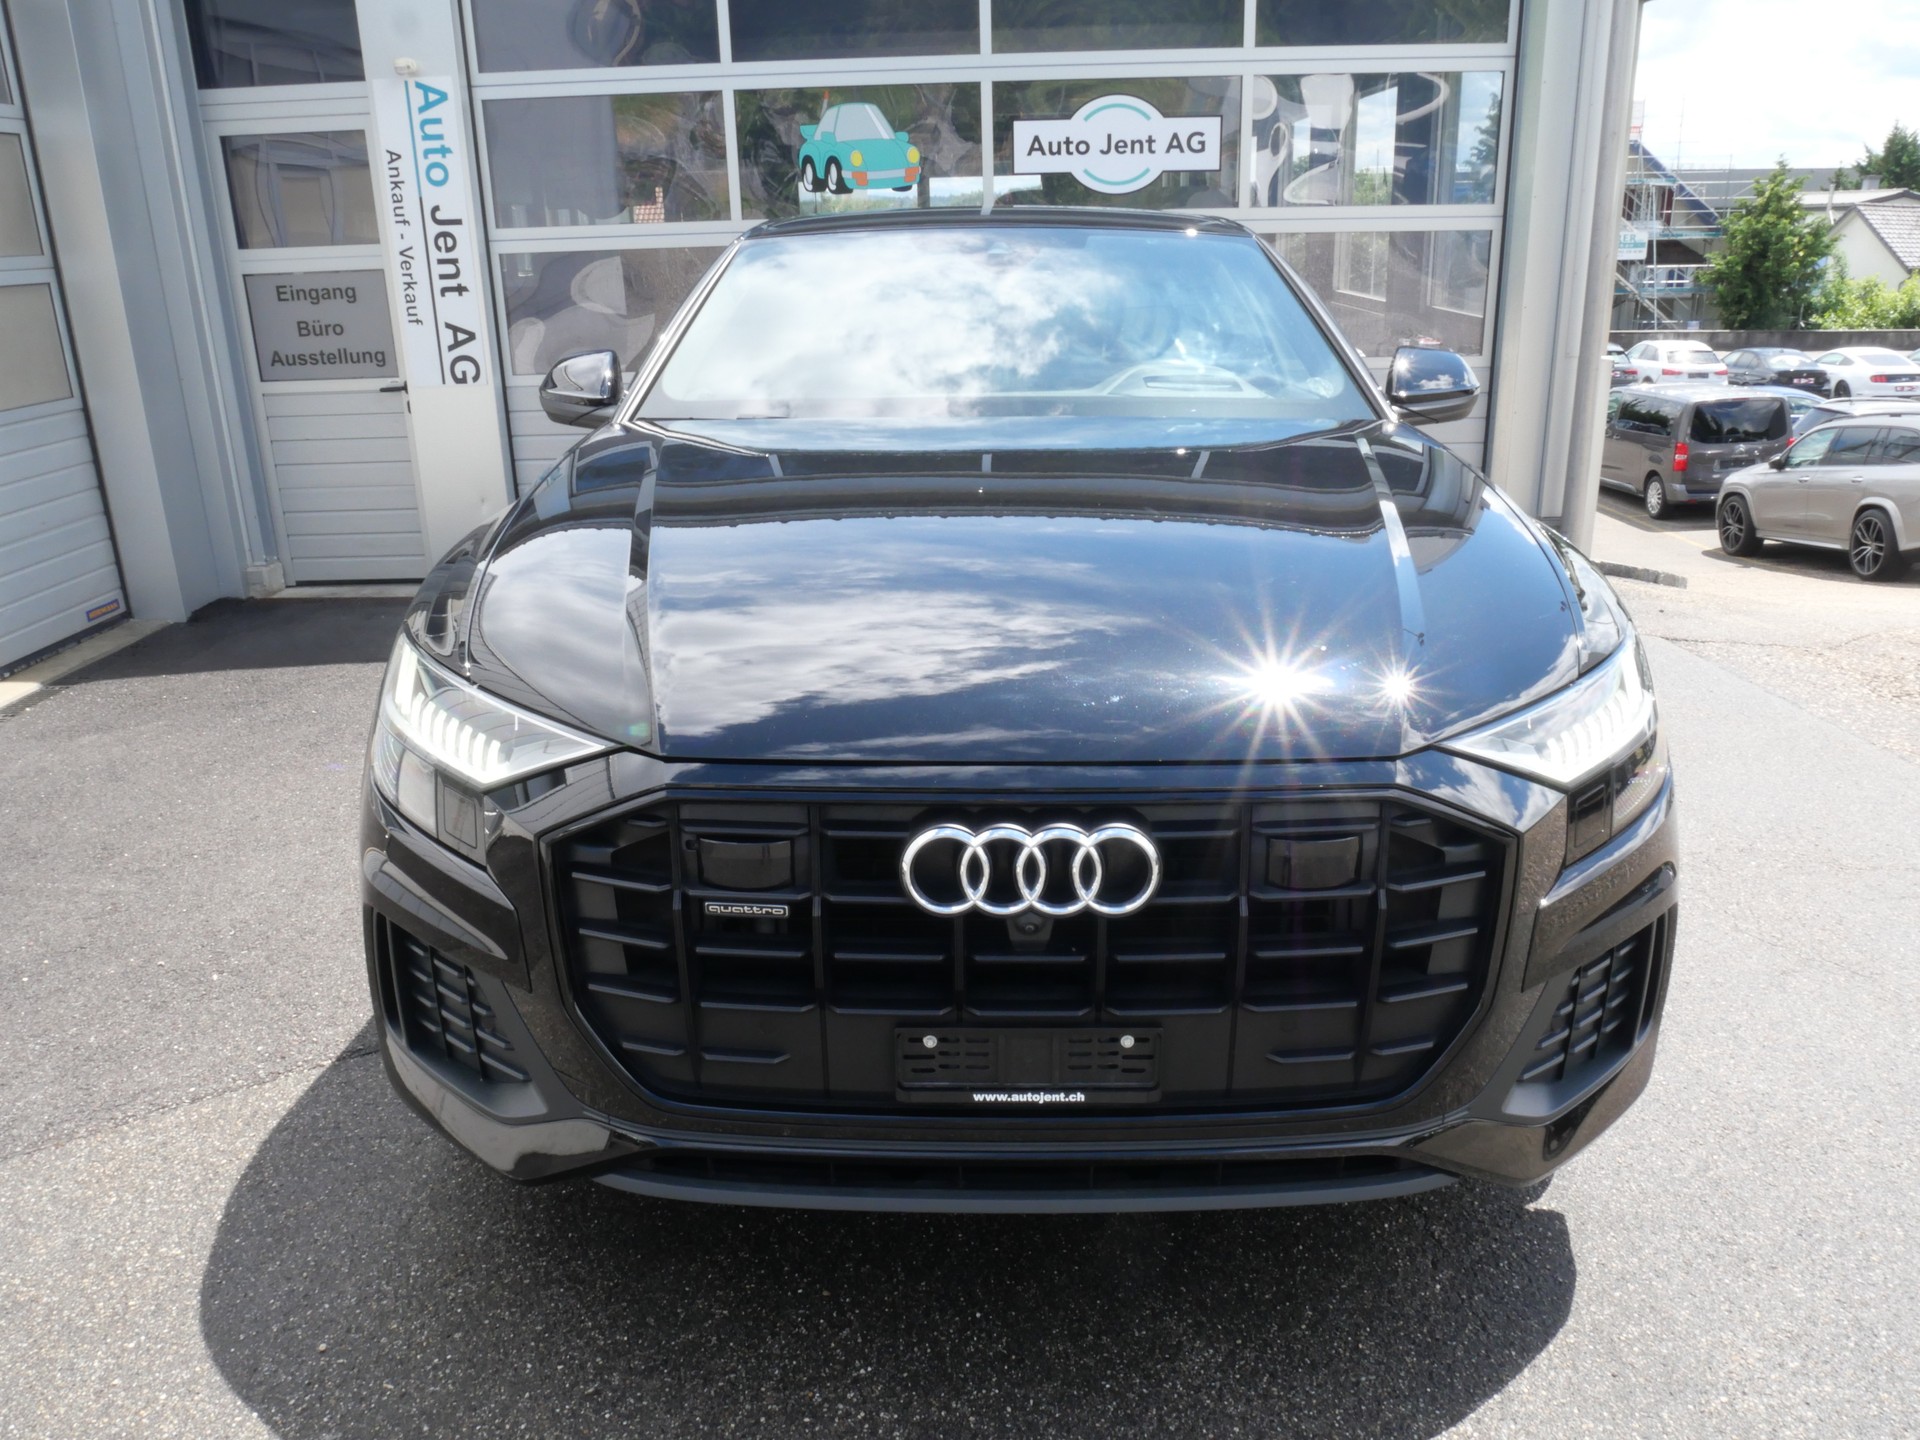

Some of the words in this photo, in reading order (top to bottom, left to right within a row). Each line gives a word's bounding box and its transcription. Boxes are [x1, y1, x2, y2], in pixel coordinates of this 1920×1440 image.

[414, 80, 454, 188] Auto
[1026, 135, 1091, 157] Auto
[1099, 133, 1157, 155] Jent
[1165, 131, 1207, 154] AG
[385, 149, 411, 226] Ankauf
[398, 246, 424, 326] Verkauf
[430, 205, 470, 298] Jent
[275, 285, 357, 305] Eingang
[296, 320, 344, 337] Büro
[270, 348, 386, 367] Ausstellung
[444, 321, 481, 385] AG
[708, 905, 785, 915] quattro
[973, 1091, 1085, 1104] www.autojent.ch
